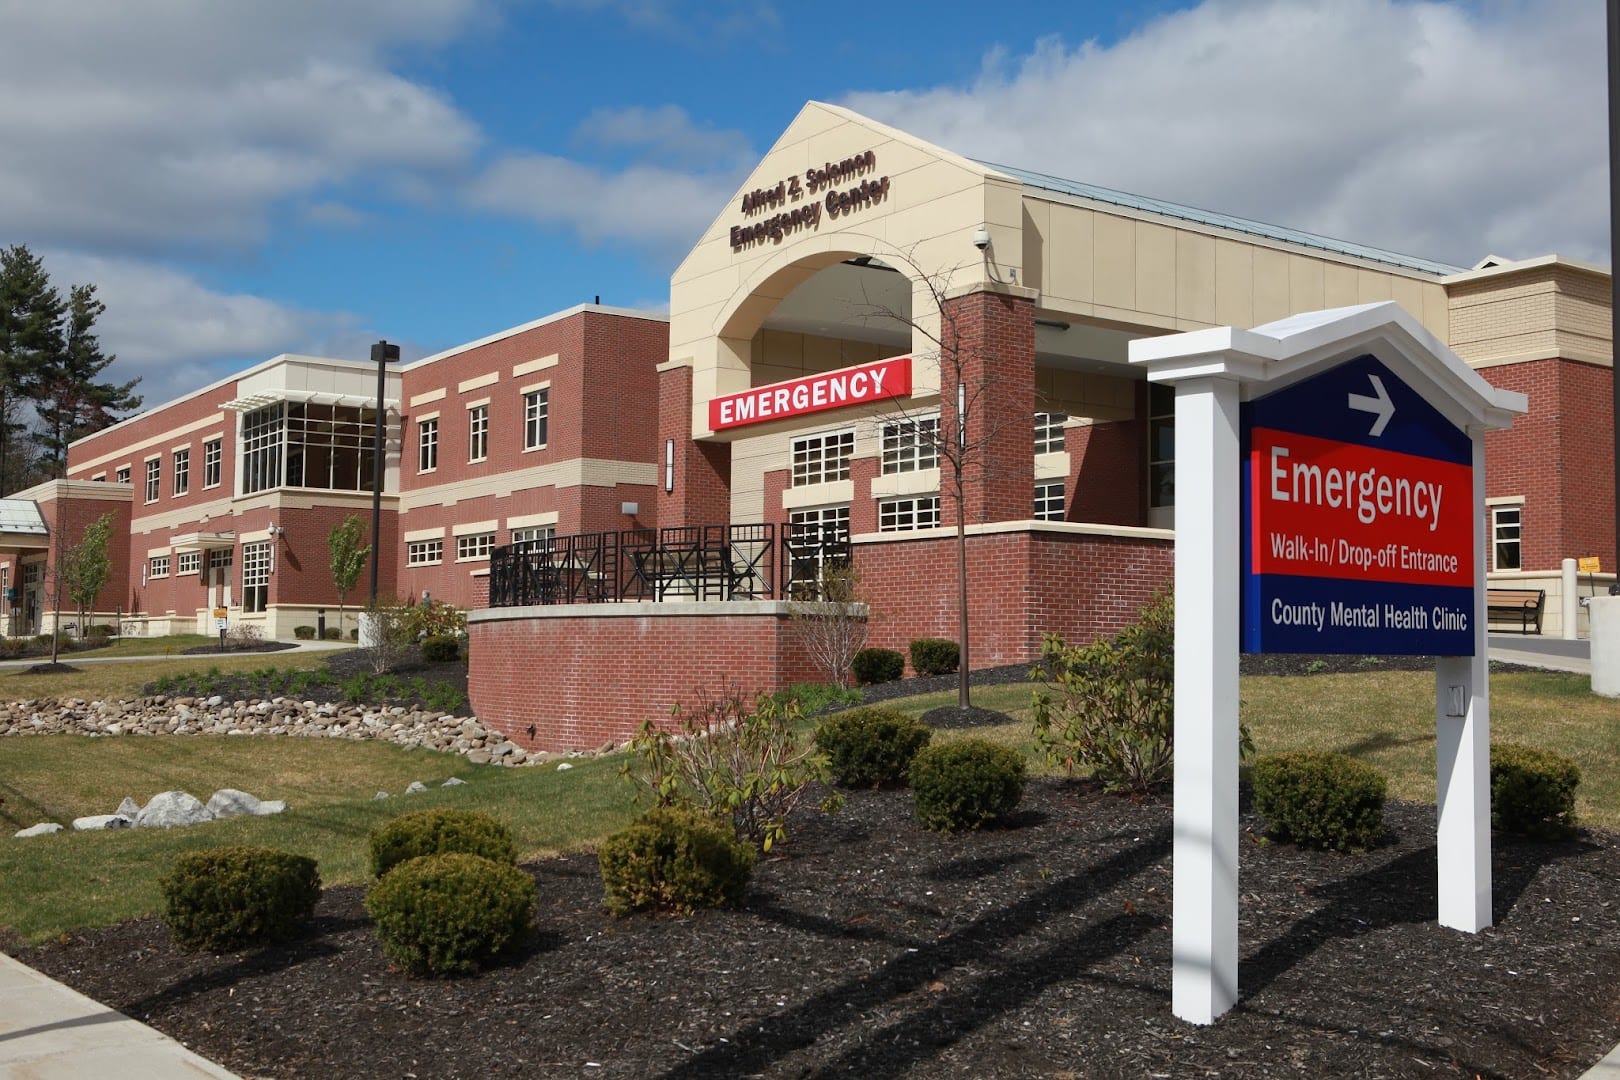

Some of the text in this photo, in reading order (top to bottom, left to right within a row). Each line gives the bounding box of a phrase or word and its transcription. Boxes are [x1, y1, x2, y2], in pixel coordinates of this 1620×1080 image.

[730, 175, 890, 248] Emergency Center
[741, 150, 876, 214] Alfred Z. Solomon
[720, 367, 887, 424] EMERGENCY
[1271, 445, 1443, 532] Emergency
[1401, 545, 1458, 573] Entrance
[1271, 598, 1468, 632] County Mental Health Clinic
